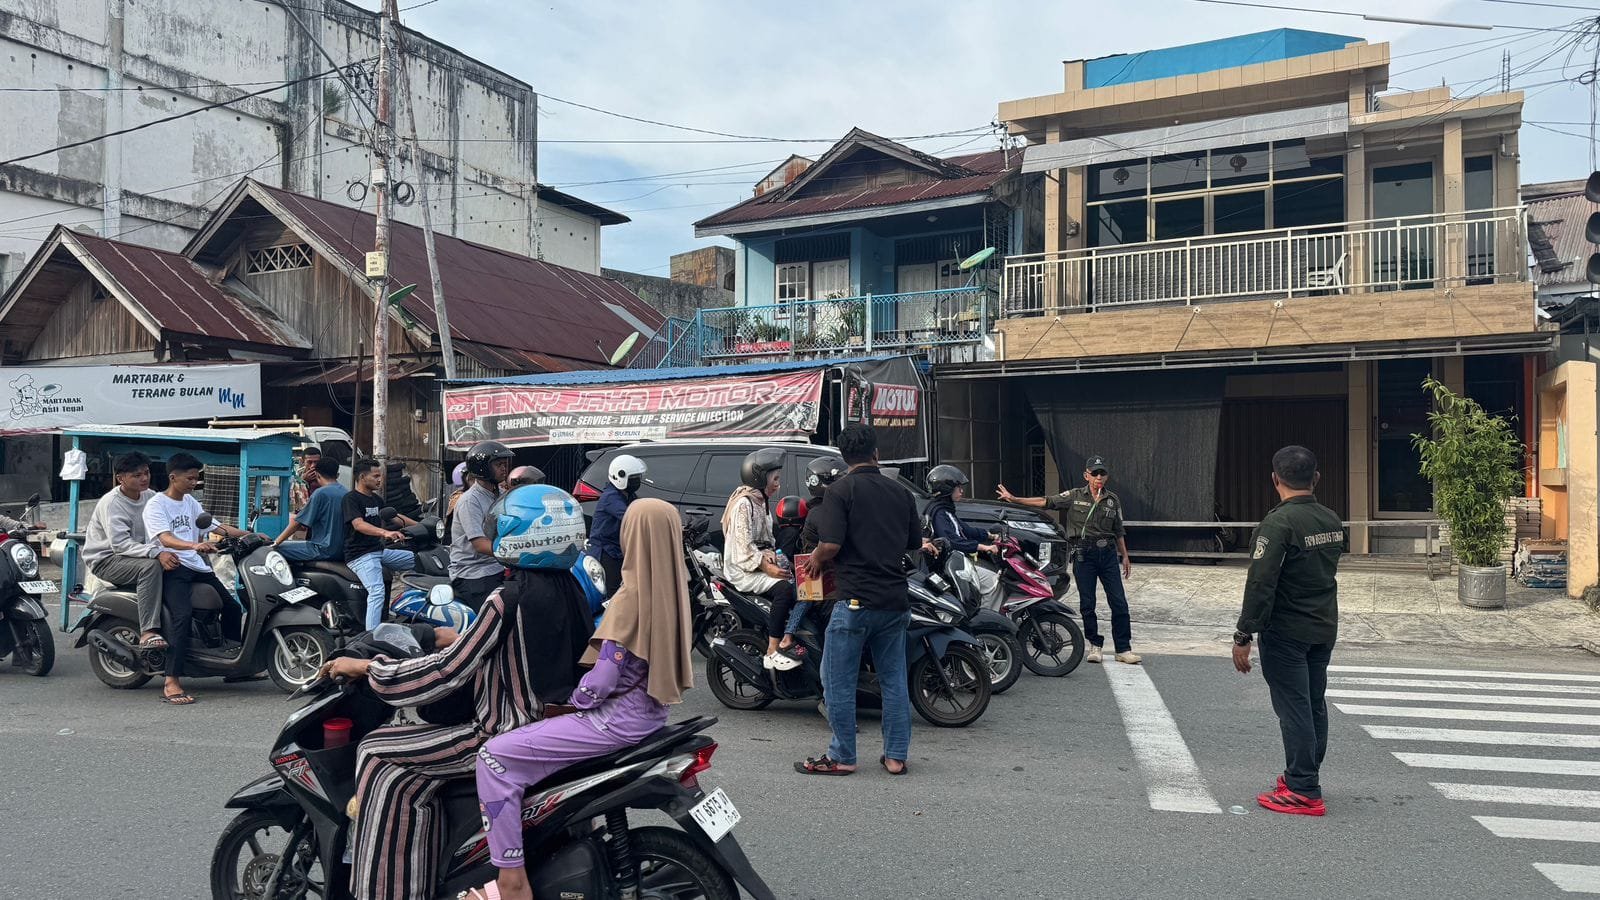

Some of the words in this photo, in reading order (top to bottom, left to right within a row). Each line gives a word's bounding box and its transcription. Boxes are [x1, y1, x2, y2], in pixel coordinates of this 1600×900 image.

[112, 374, 174, 384] MARTABAK
[177, 374, 185, 382] &
[42, 397, 82, 405] MARTABAK
[131, 388, 176, 399] TERANG
[179, 387, 214, 397] BULAN
[474, 391, 562, 418] DENNY
[567, 388, 650, 412] JAYA
[658, 381, 778, 411] MOTOR
[873, 387, 916, 411] MOTUL
[496, 417, 532, 431] SPAREPART
[536, 416, 559, 427] GANTI
[559, 416, 571, 426] OLI
[577, 415, 611, 426] SERVICE
[620, 415, 641, 425] TUNE
[641, 415, 654, 424] UP
[659, 412, 696, 423] SERVICE
[696, 410, 744, 423] INJECTION
[508, 534, 571, 550] revolution
[702, 796, 722, 817] 6675
